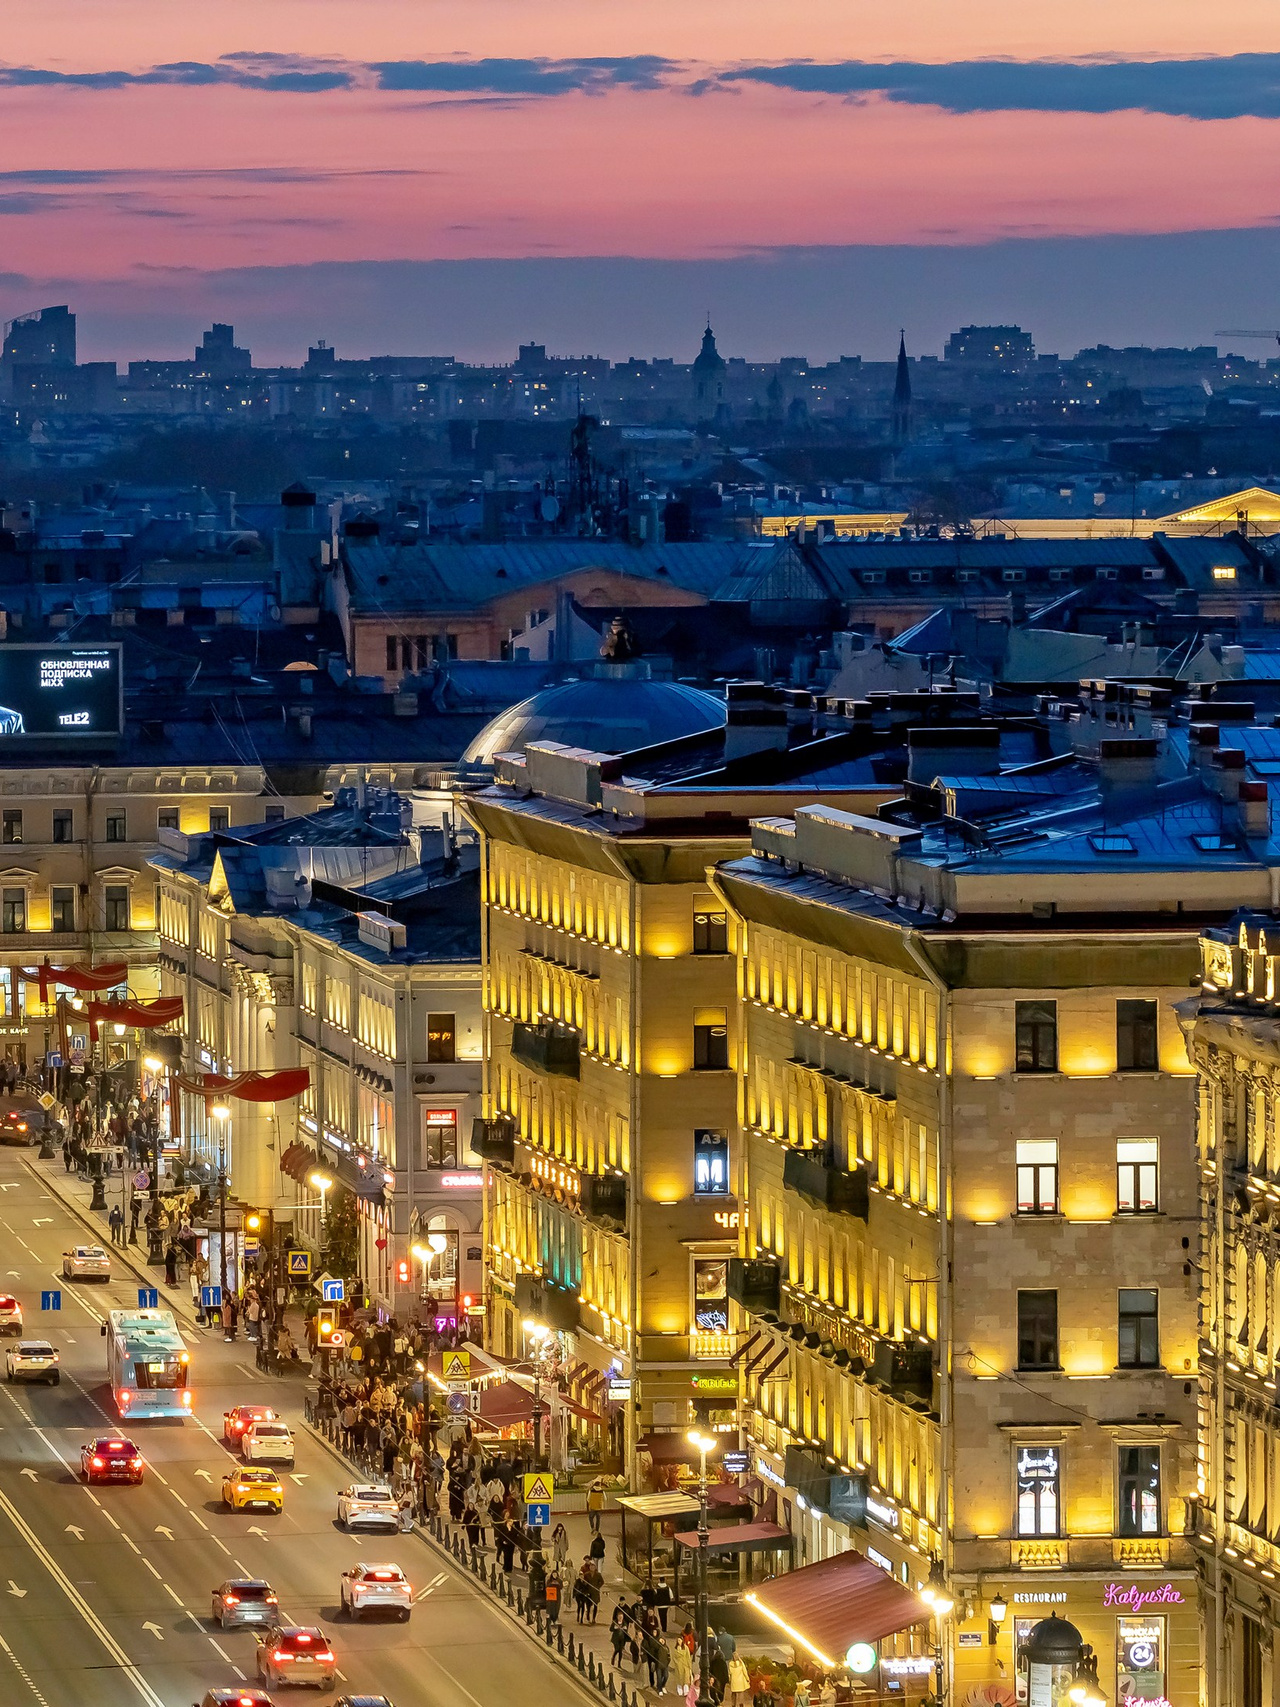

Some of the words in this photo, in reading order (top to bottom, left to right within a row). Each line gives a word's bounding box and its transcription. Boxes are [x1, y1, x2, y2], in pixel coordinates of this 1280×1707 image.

[40, 660, 110, 670] ОБНОВЛЕННАЯ
[40, 669, 93, 679] ПОДПИСКА
[58, 711, 90, 725] TELE2
[1013, 1592, 1067, 1603] RESTAURANT
[1103, 1583, 1185, 1612] Katyusha
[1134, 1647, 1150, 1660] 24
